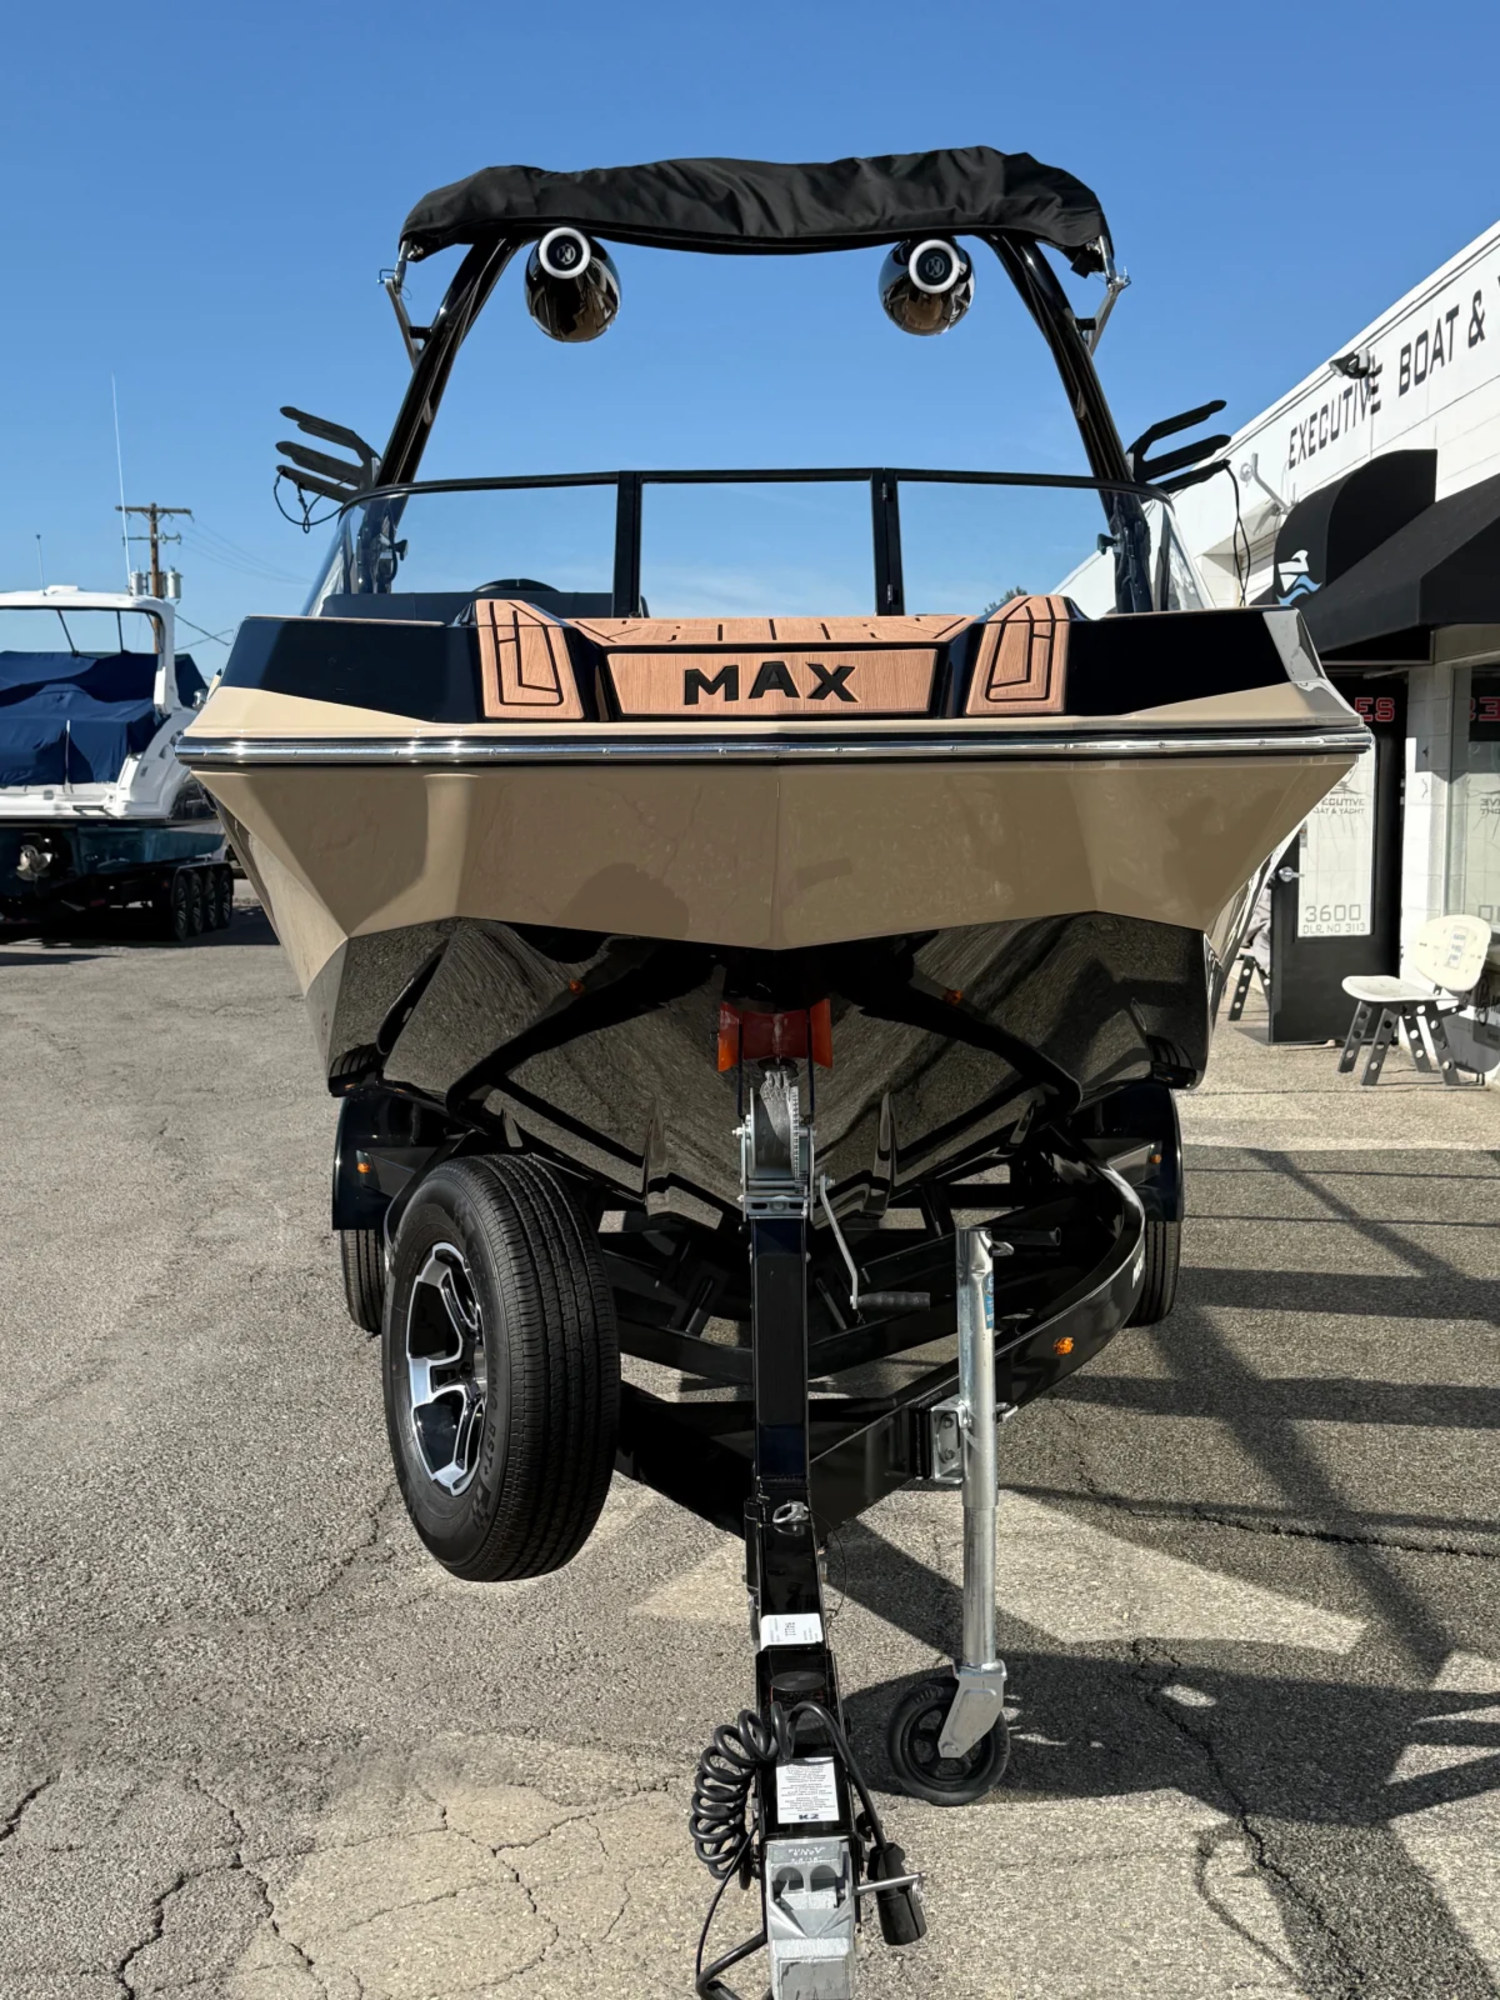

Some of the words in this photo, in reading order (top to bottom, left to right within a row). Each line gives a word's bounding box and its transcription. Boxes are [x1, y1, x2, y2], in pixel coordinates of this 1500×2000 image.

[1289, 363, 1383, 470] EXECUTIVE
[1399, 304, 1459, 398] BOAT
[1468, 289, 1486, 349] &
[684, 660, 860, 706] MAX
[1339, 807, 1365, 815] YACHT
[1305, 904, 1361, 923] 3600
[1327, 923, 1341, 933] NO
[1345, 922, 1366, 933] 3113
